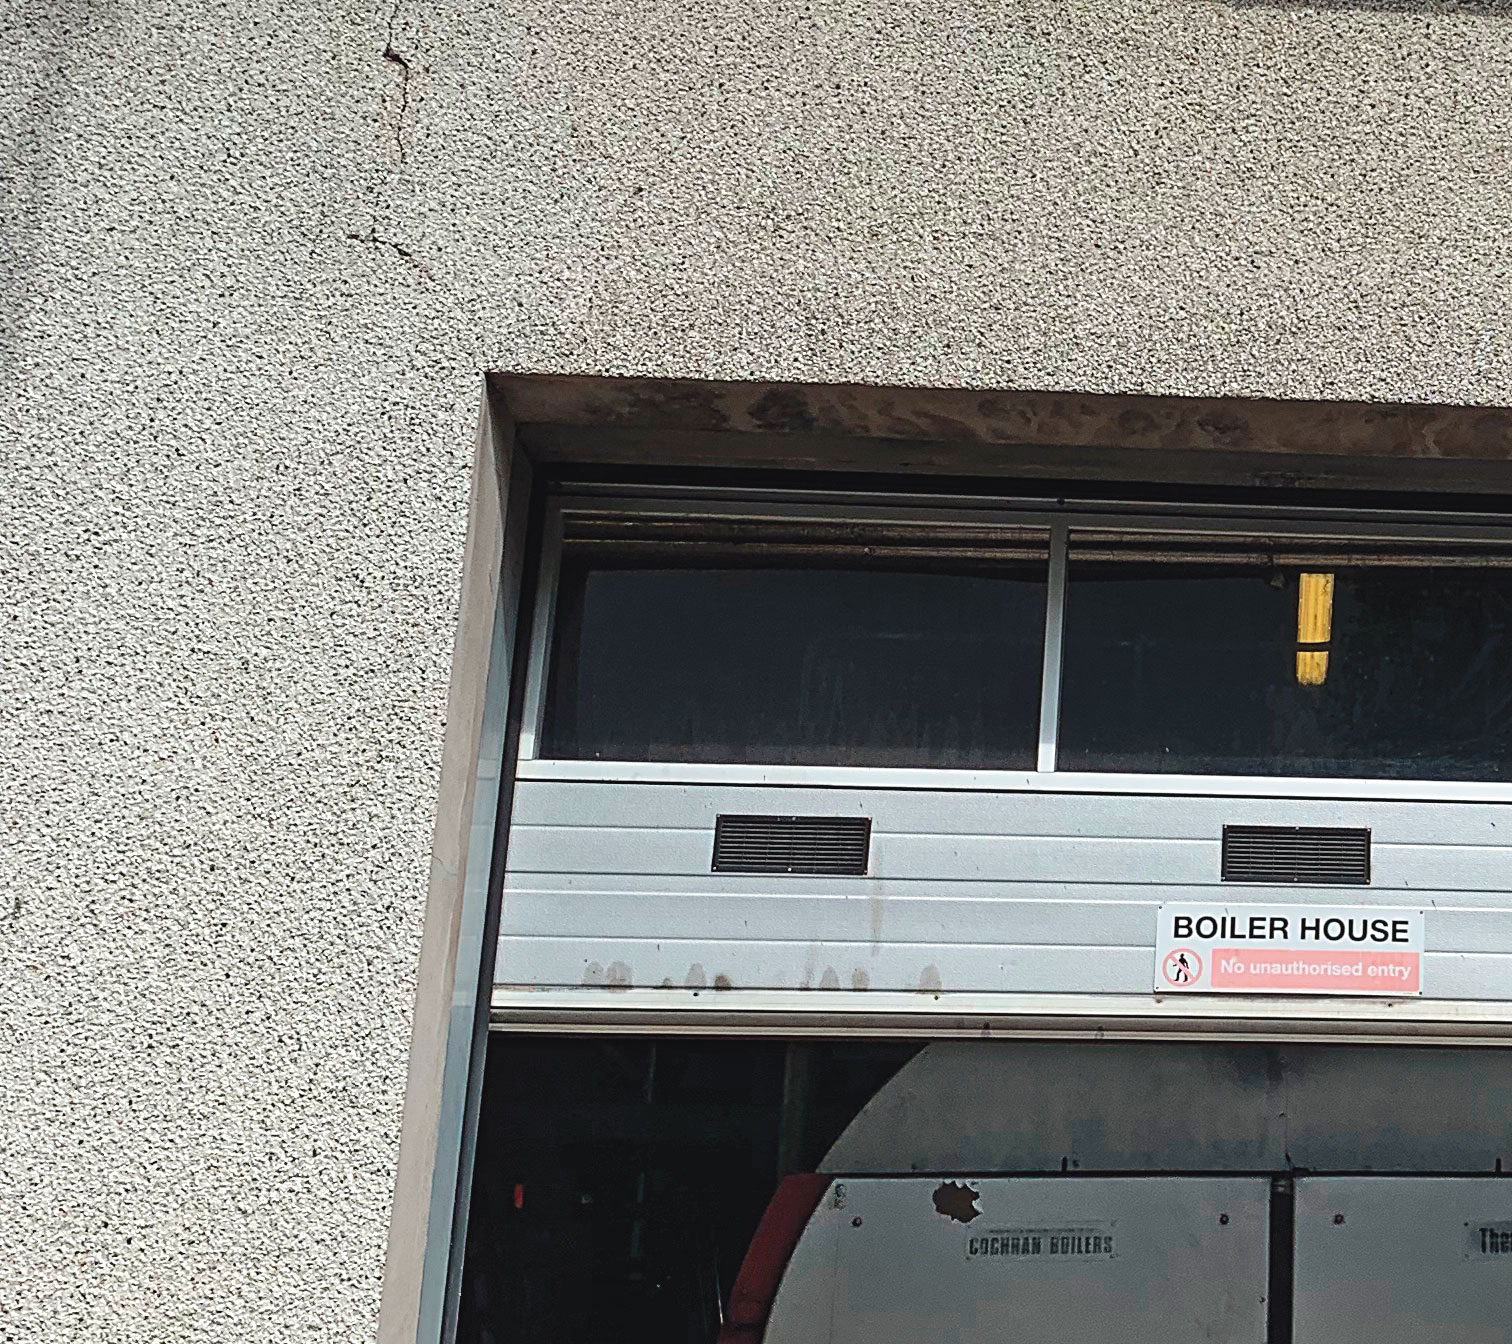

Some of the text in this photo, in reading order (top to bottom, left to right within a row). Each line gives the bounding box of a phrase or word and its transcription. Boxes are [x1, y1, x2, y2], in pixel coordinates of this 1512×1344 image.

[1173, 916, 1410, 943] BOILER HOUSE
[1220, 959, 1411, 981] No unauthorised entry
[969, 1236, 1113, 1256] COCHRAN BOILERS
